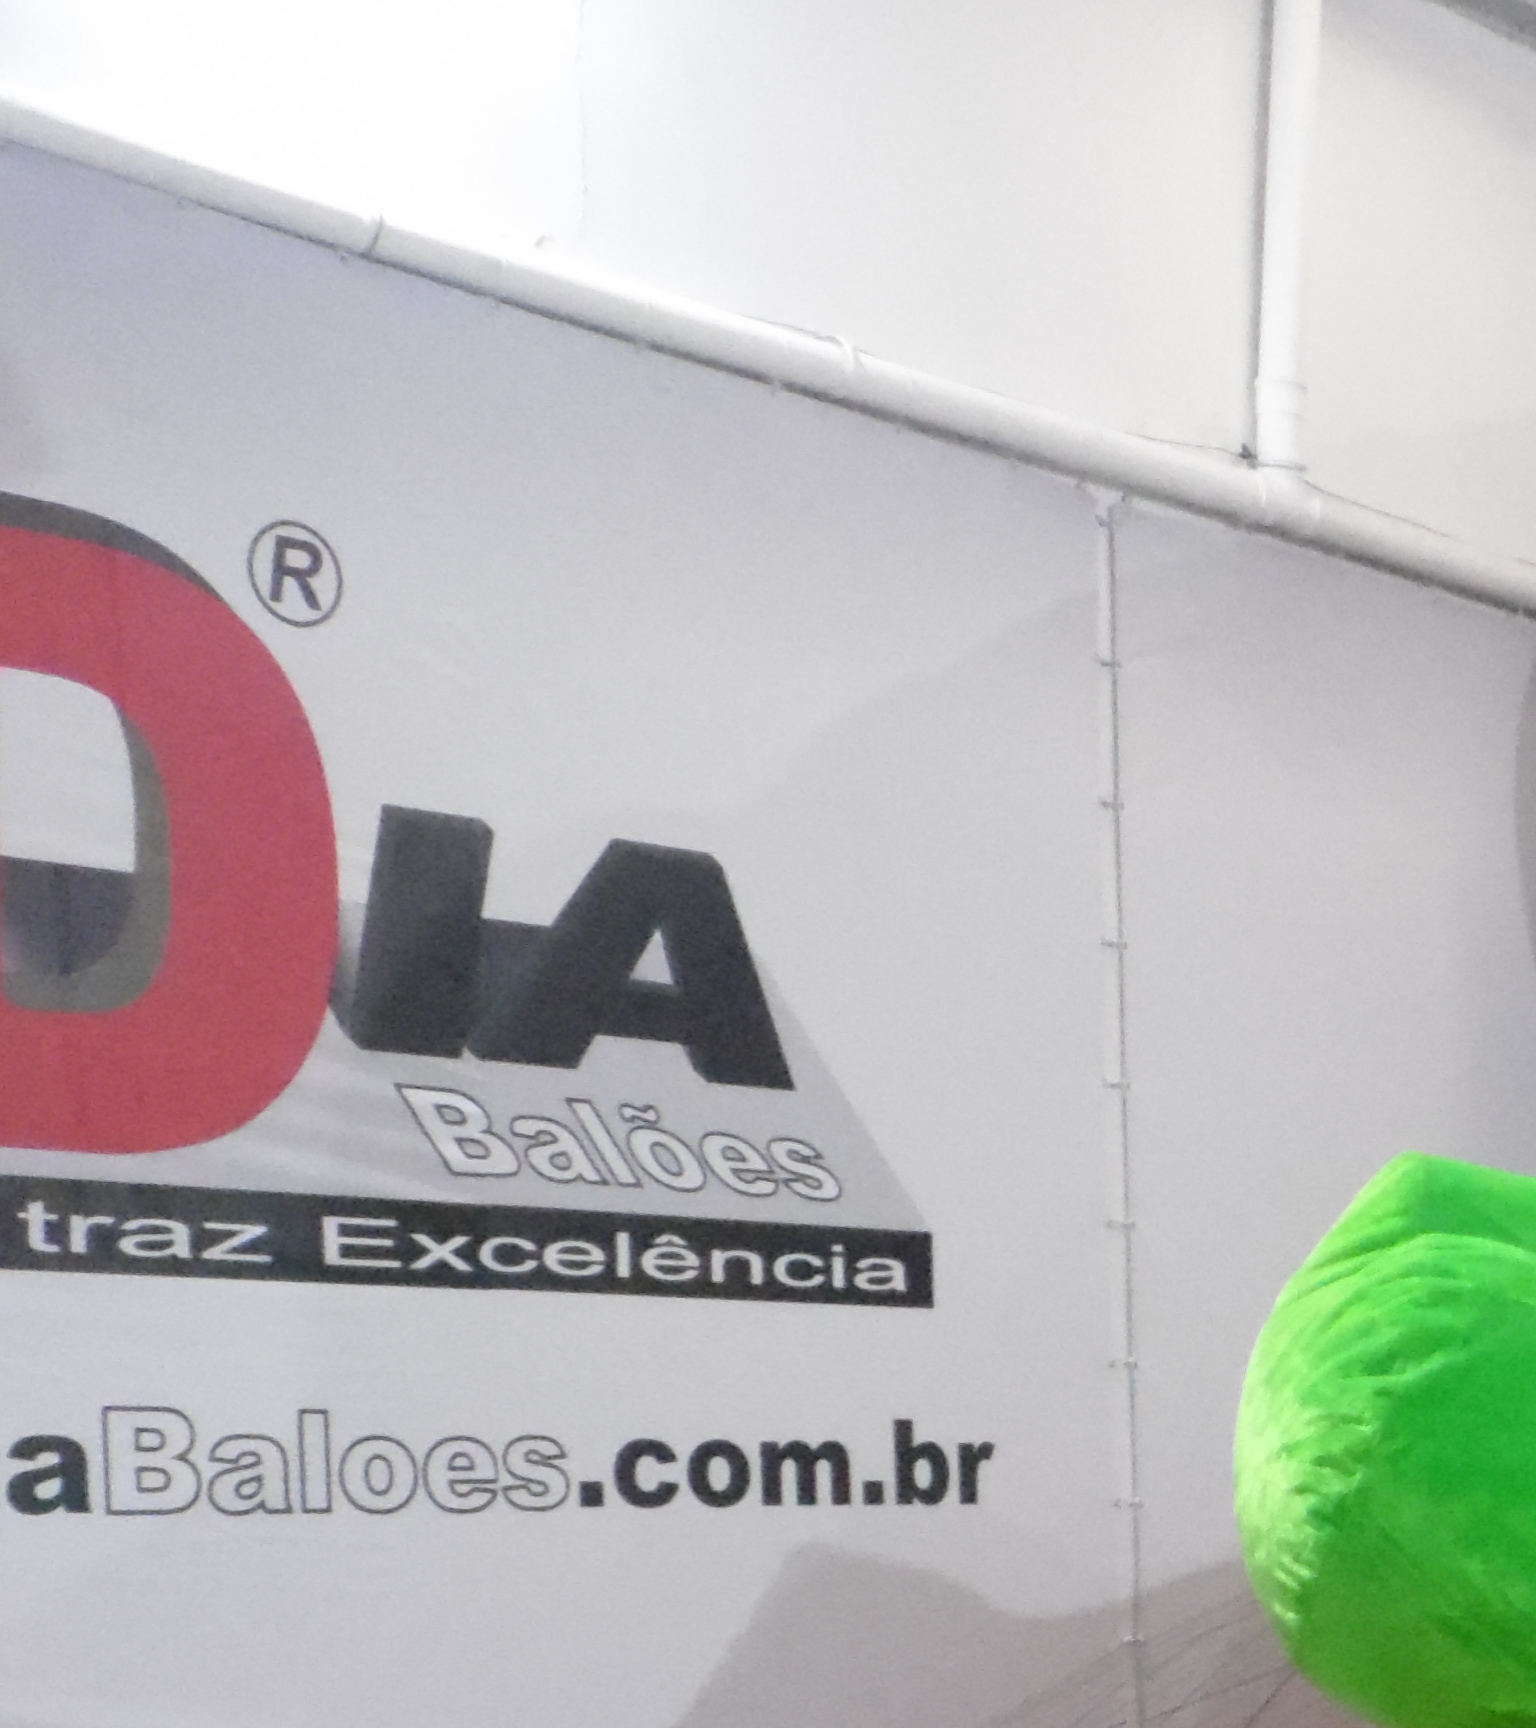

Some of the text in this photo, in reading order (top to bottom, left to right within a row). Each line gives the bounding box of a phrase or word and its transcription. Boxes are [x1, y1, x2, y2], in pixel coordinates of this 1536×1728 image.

[395, 1083, 842, 1202] Balões
[17, 1200, 908, 1294] traz Excelência
